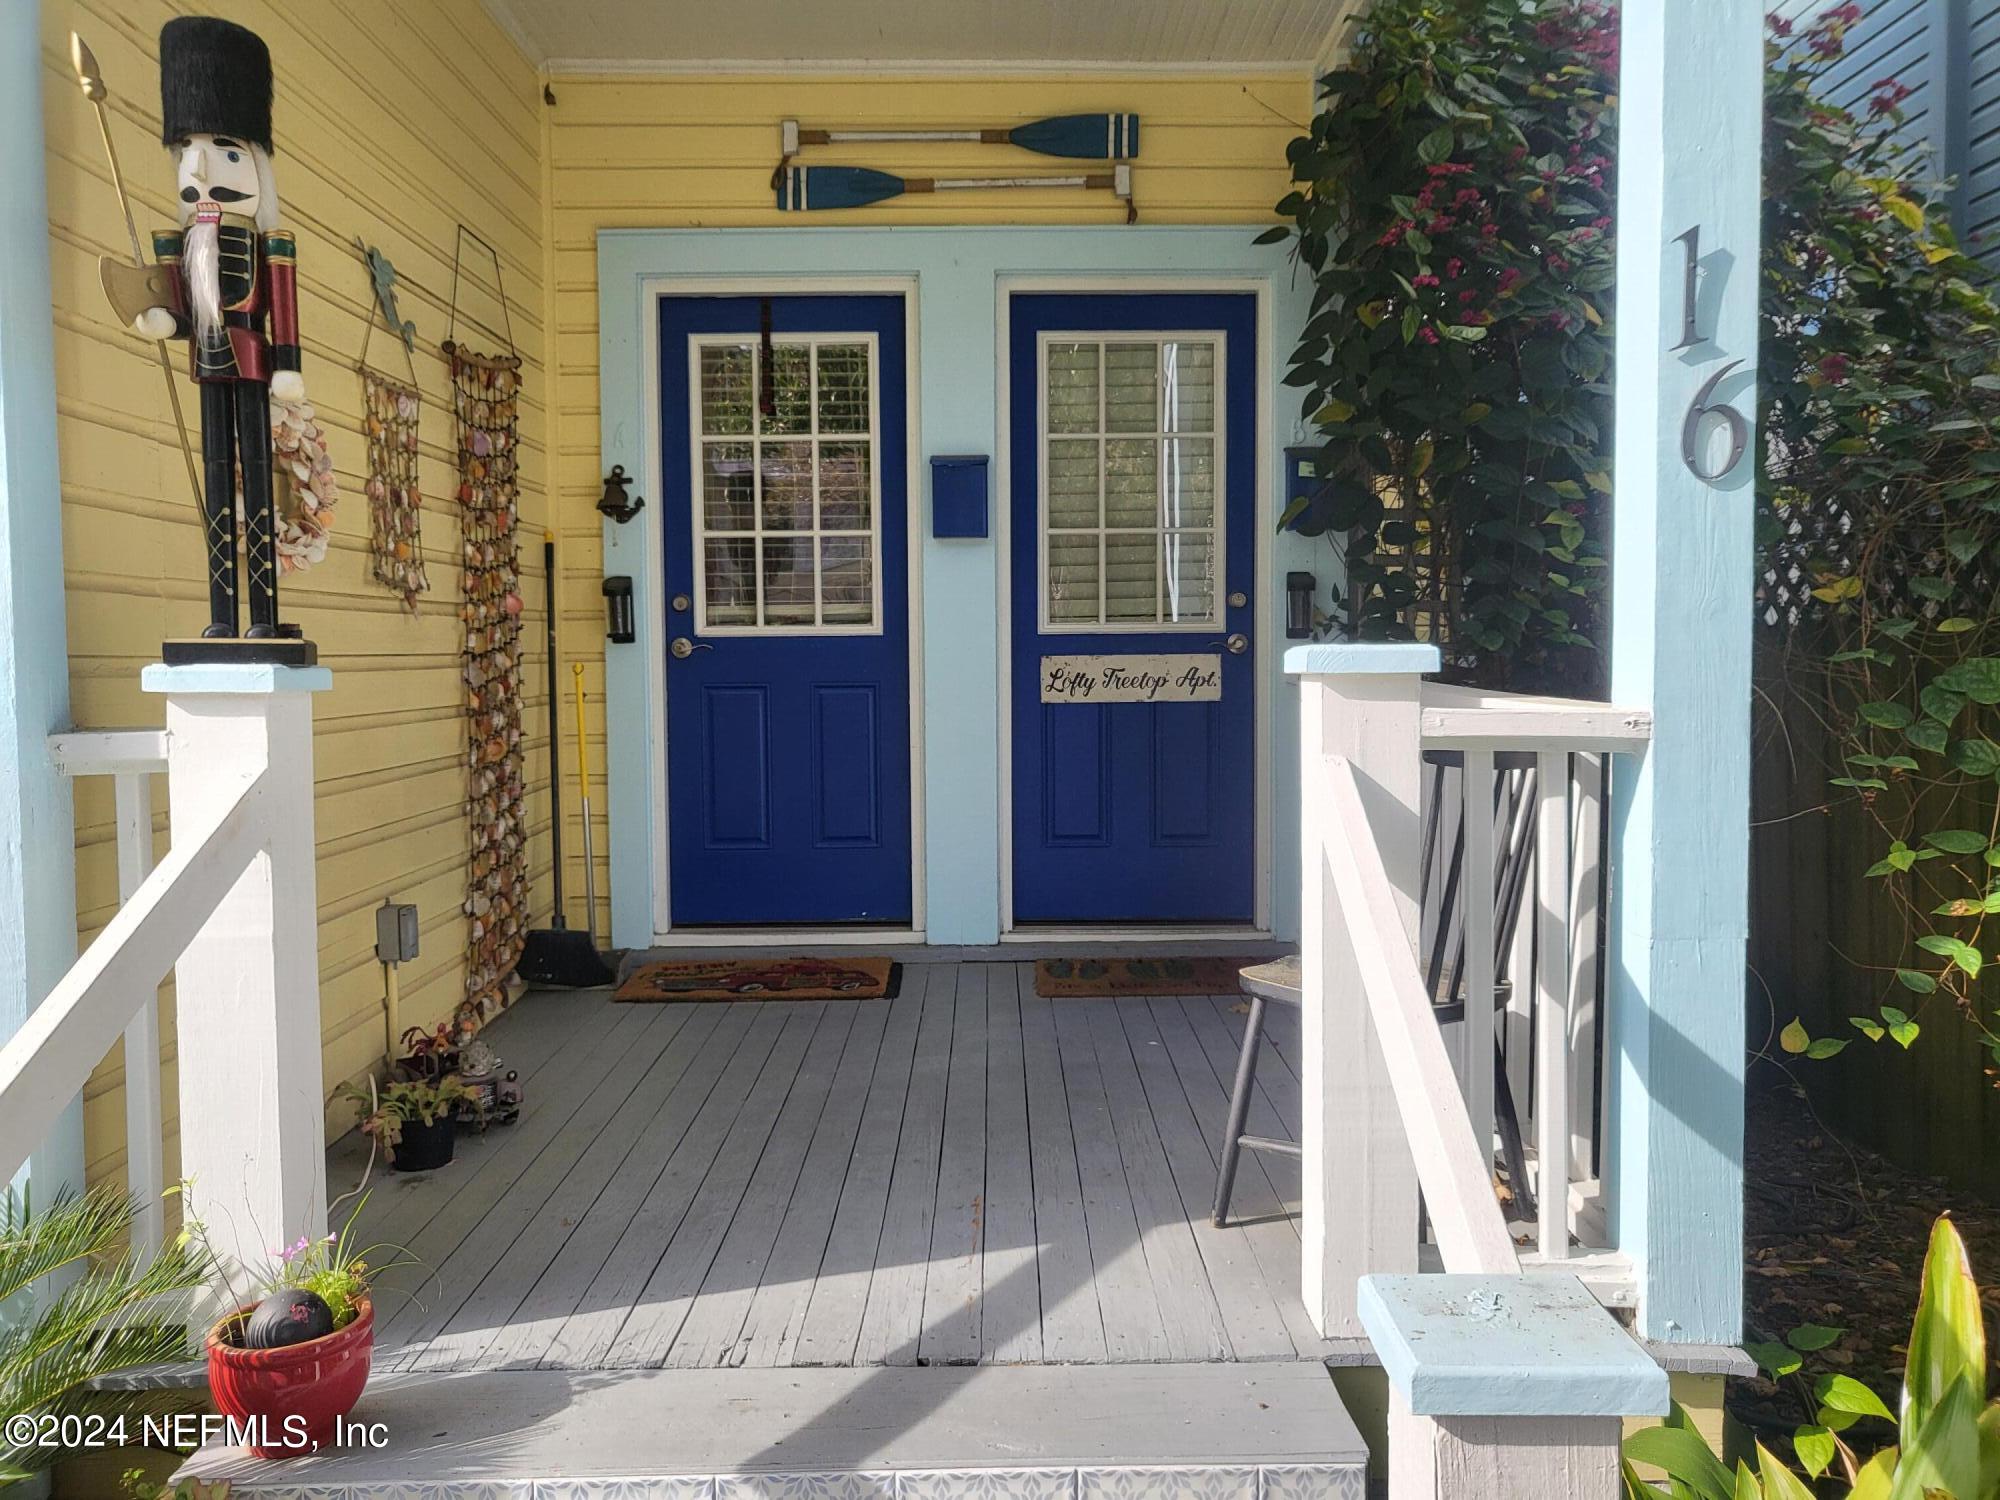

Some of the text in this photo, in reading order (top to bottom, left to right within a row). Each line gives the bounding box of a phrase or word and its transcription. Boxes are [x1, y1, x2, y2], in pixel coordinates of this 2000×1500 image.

[1668, 223, 1748, 480] 16
[1045, 666, 1217, 699] Lofty Treetop Apt.
